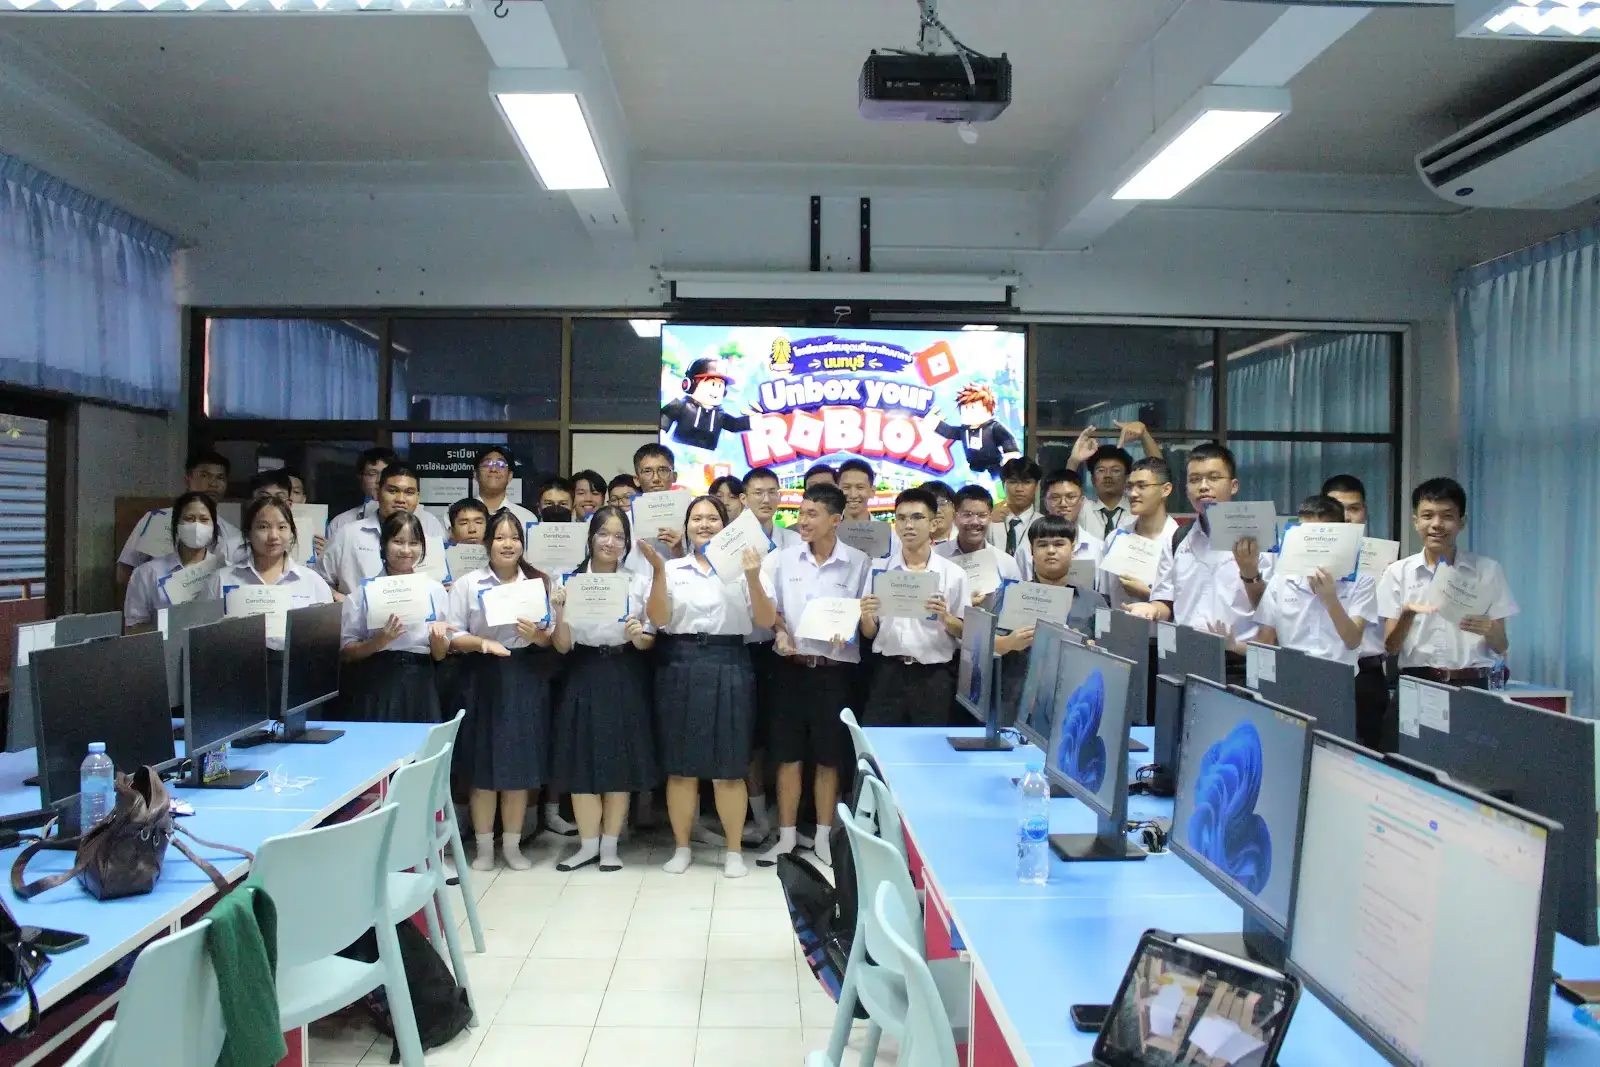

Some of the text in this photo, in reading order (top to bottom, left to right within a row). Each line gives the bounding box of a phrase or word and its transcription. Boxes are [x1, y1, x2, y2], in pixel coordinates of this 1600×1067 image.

[823, 353, 865, 371] นนทบุรี
[760, 375, 934, 412] Unbox your
[446, 448, 479, 459] ระเบีย
[416, 460, 475, 473] การใช้ห้องปฏิบัติกา
